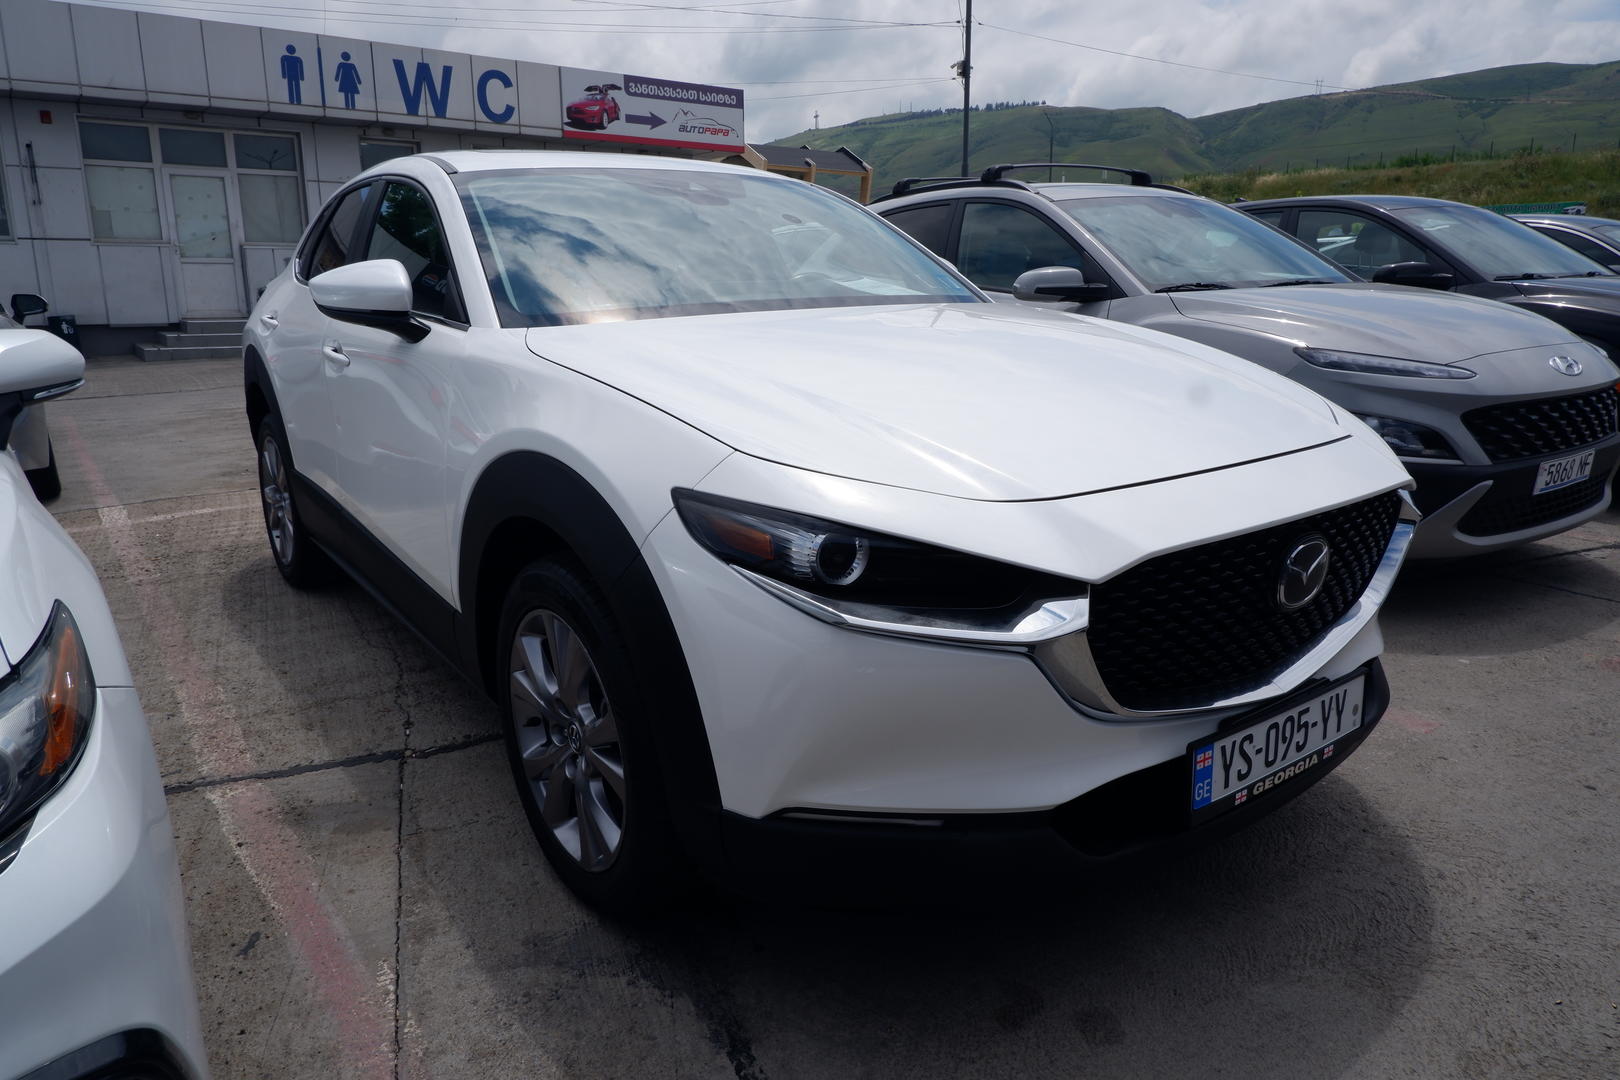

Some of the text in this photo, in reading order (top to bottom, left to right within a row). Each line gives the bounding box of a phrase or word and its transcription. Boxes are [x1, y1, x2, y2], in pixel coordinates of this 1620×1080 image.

[699, 91, 737, 105] საიტზე
[1220, 689, 1348, 790] YS-095-YY
[1194, 778, 1211, 801] GE
[1252, 755, 1319, 796] GEORGIA
